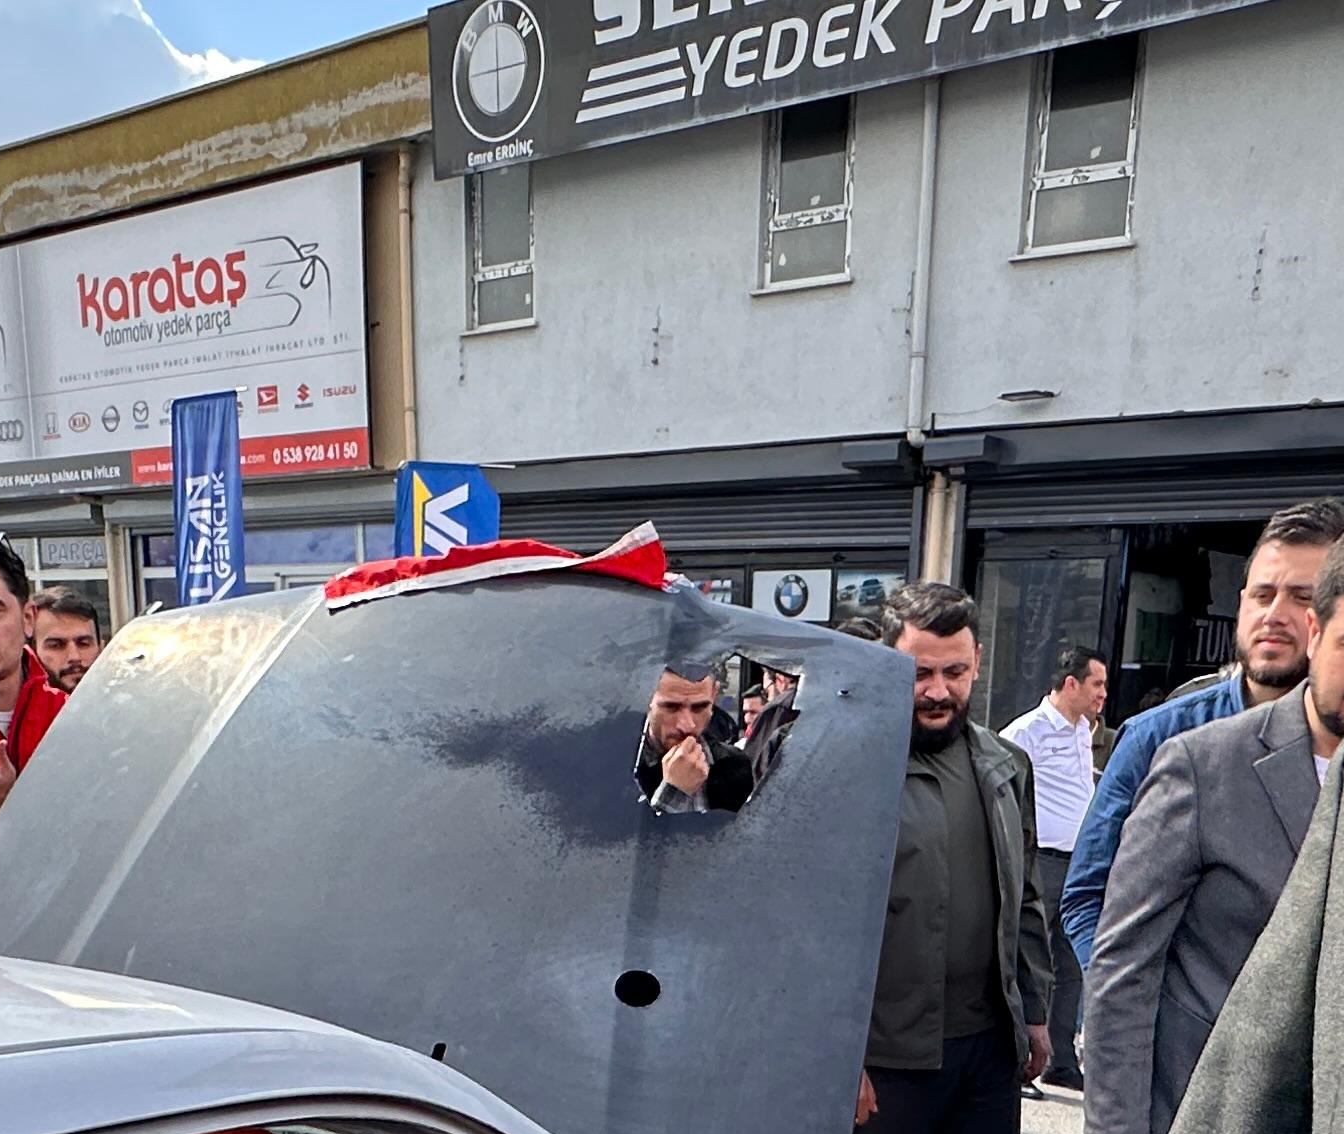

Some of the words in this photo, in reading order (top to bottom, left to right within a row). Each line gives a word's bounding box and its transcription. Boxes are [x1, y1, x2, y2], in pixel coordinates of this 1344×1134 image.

[462, 2, 534, 52] BMW
[686, 0, 902, 97] YEDEK
[467, 151, 493, 167] Emre
[76, 249, 247, 336] karataş
[103, 320, 153, 347] otomotiv
[156, 311, 193, 343] yedek
[196, 309, 231, 336] parça
[322, 384, 357, 398] ISUZU
[71, 416, 89, 428] KIA
[272, 447, 282, 465] 0
[282, 446, 303, 464] 538
[304, 444, 325, 462] 928
[326, 443, 341, 461] 41
[342, 440, 358, 459] 50
[15, 472, 50, 487] PARÇADA
[51, 469, 80, 484] DAİMA
[81, 469, 93, 481] EN
[1195, 618, 1236, 664] TUN
